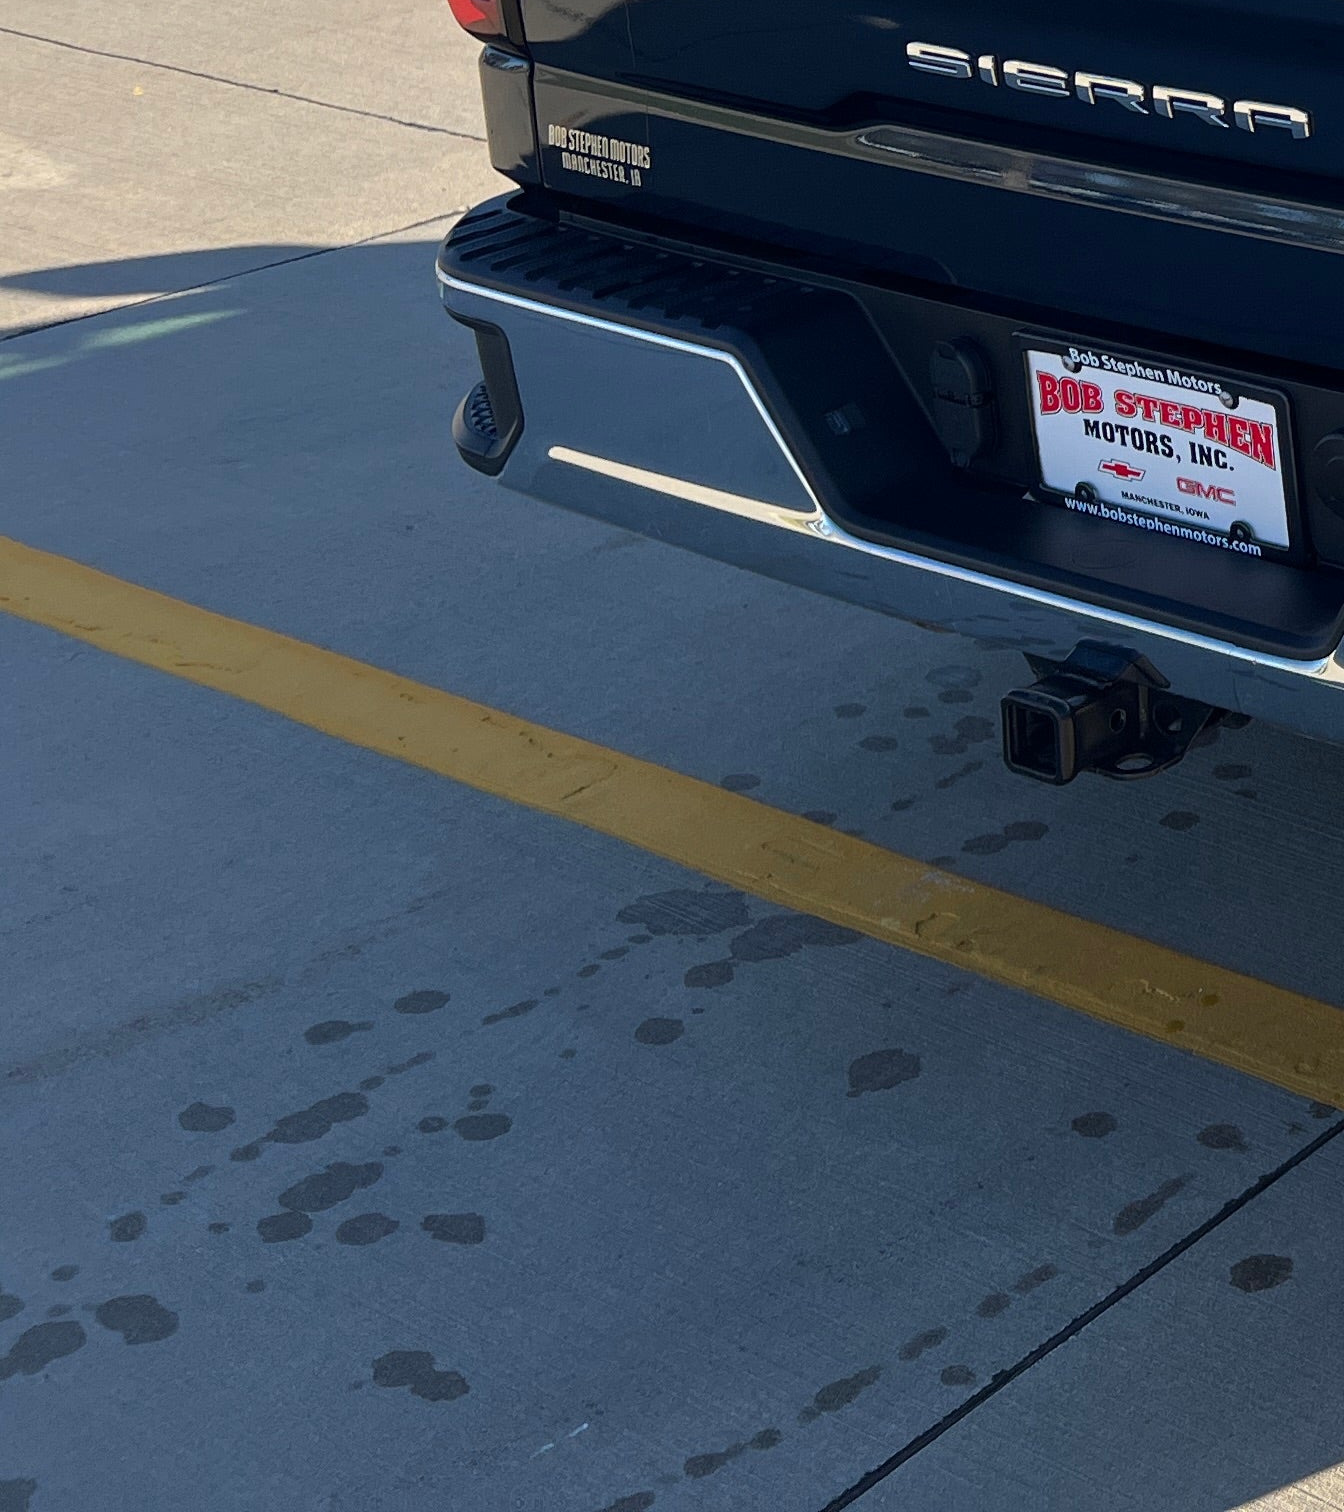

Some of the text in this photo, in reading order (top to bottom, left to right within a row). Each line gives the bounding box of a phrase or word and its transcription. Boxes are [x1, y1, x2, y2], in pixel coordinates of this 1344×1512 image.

[906, 41, 1312, 140] SIERRA
[548, 124, 651, 169] BOB STEPHEN MOTORS
[630, 168, 642, 187] IA
[1069, 347, 1223, 395] Bob Stephen Motors
[1036, 370, 1277, 471] BOB STEPHEN
[1083, 418, 1235, 471] MOTORS, INC.
[1121, 490, 1210, 520] MANCHESTER, IOWA
[1176, 476, 1236, 506] GMC
[1064, 497, 1262, 556] www.bobstephenmotors.com
